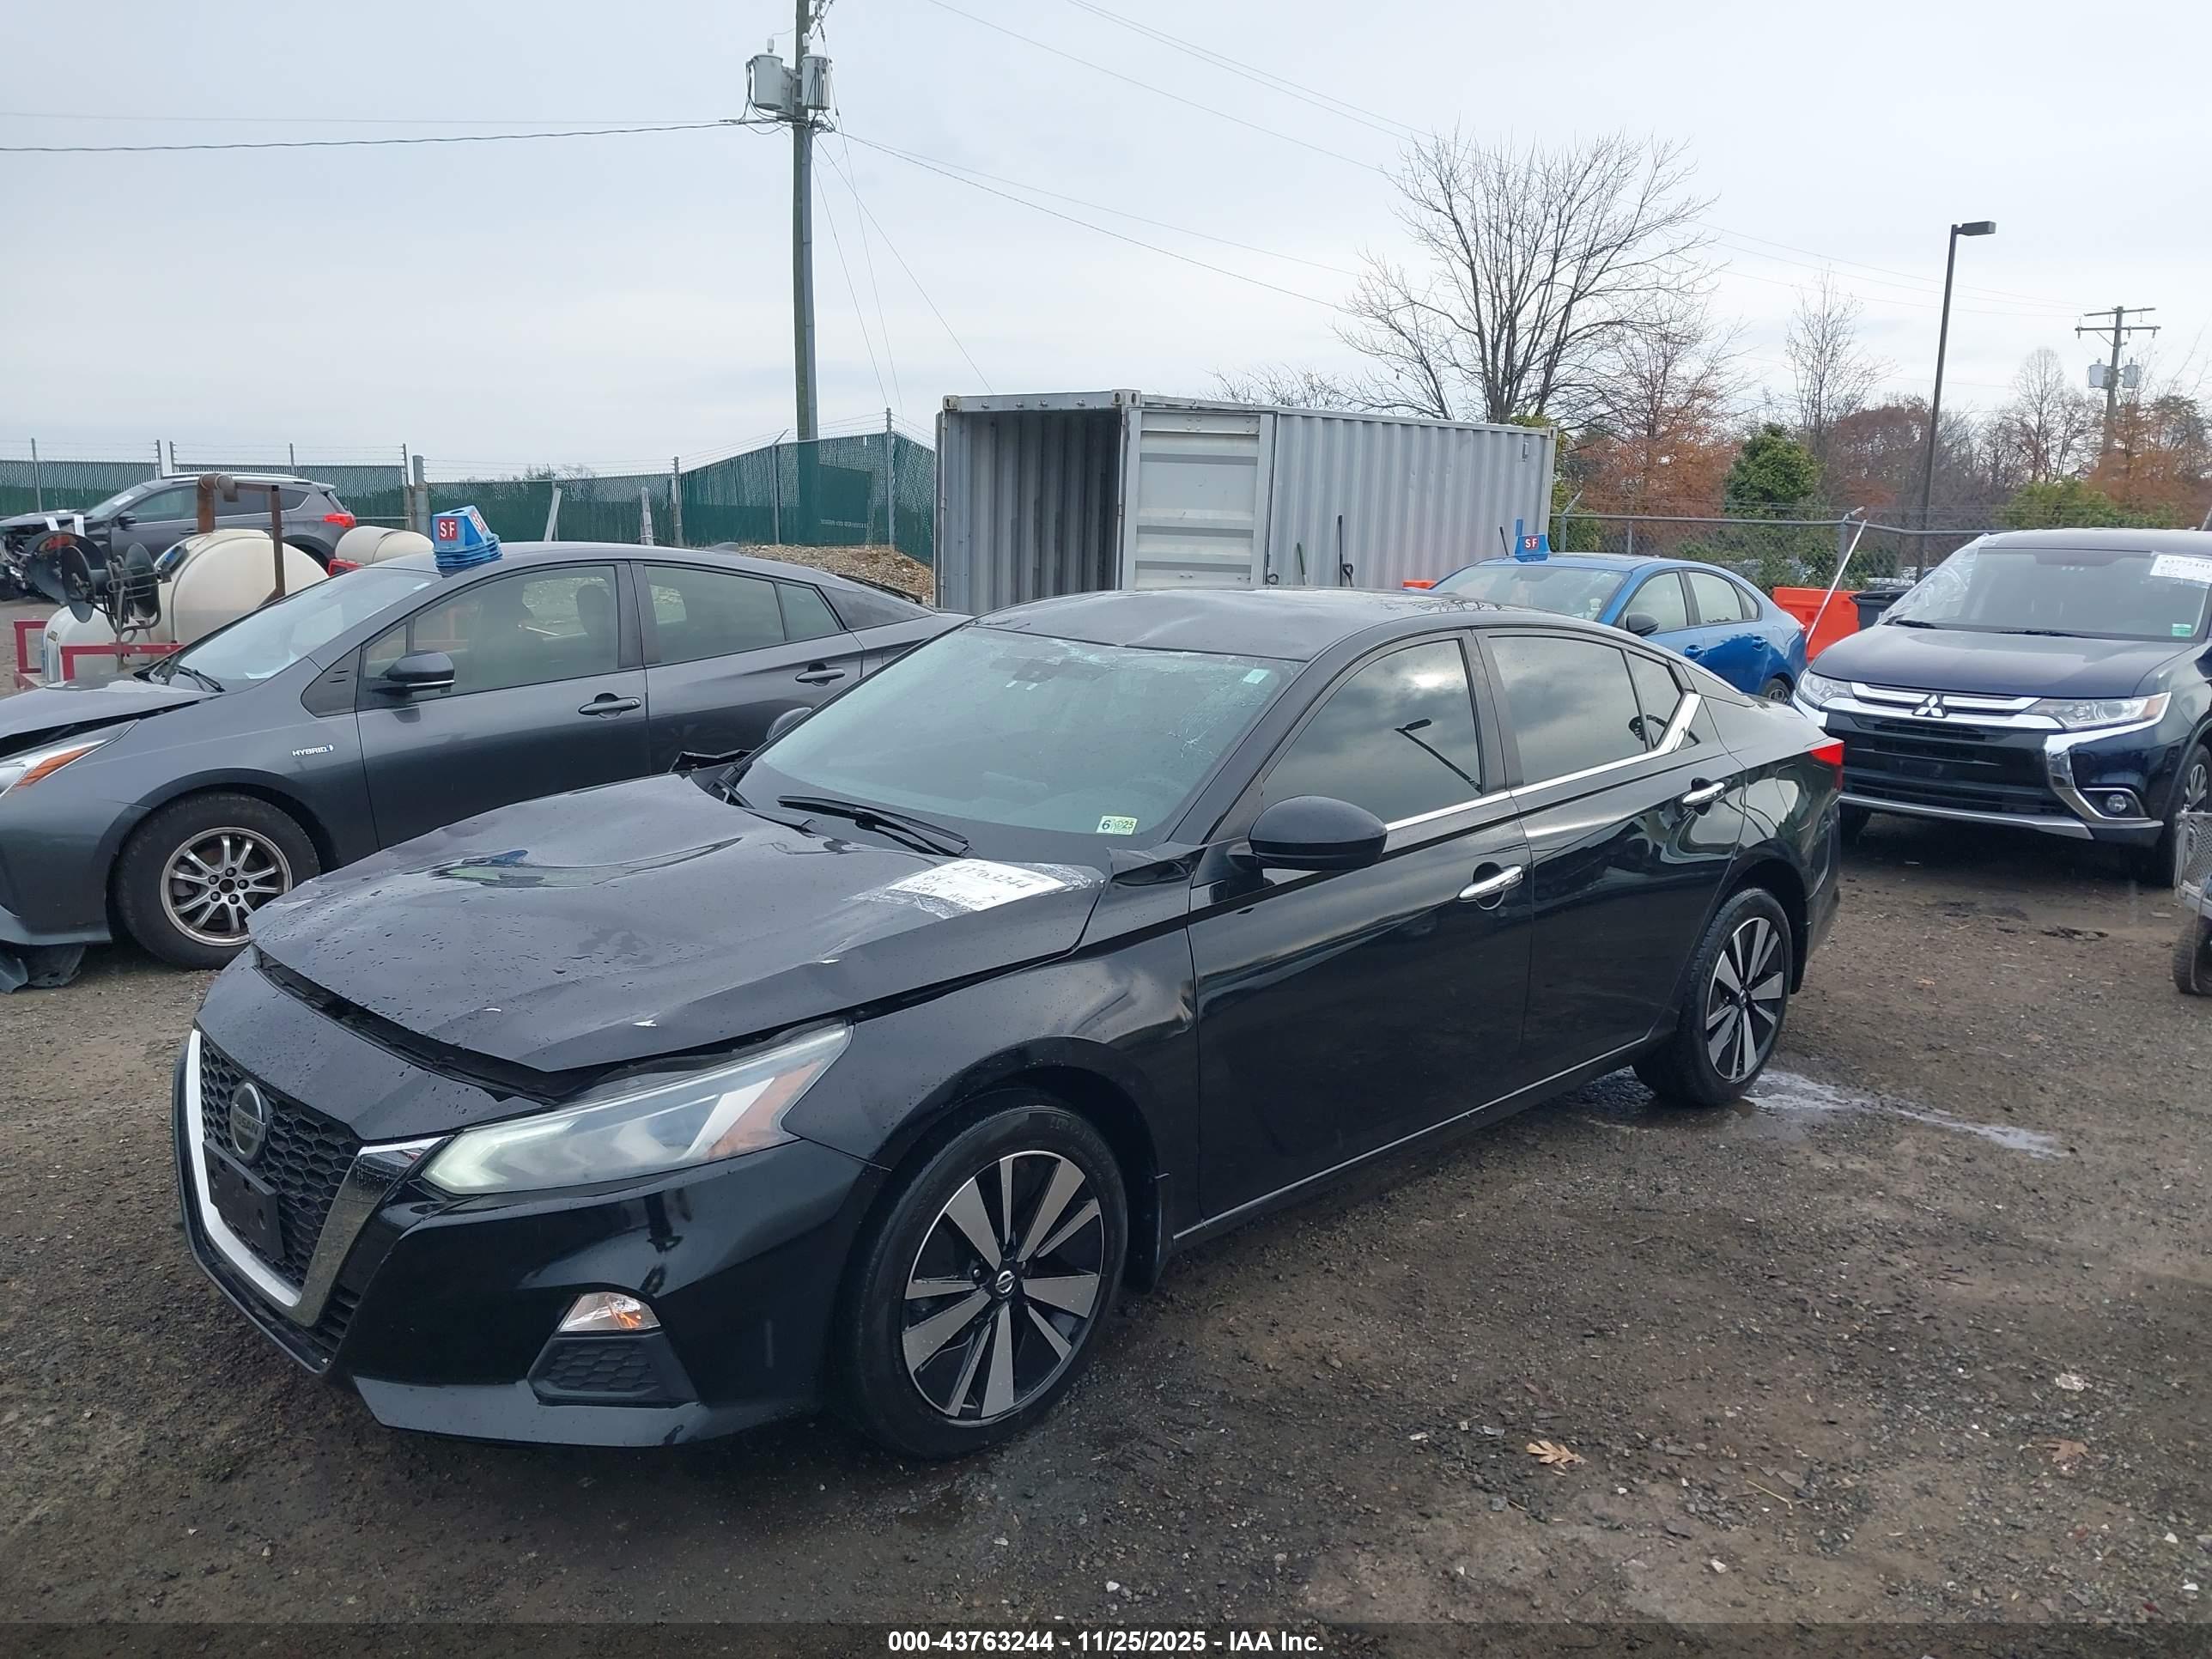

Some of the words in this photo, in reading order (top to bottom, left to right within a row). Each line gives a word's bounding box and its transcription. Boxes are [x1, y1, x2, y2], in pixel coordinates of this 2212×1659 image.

[440, 521, 455, 538] SF
[1525, 538, 1538, 549] SF
[292, 746, 327, 757] HYBRID
